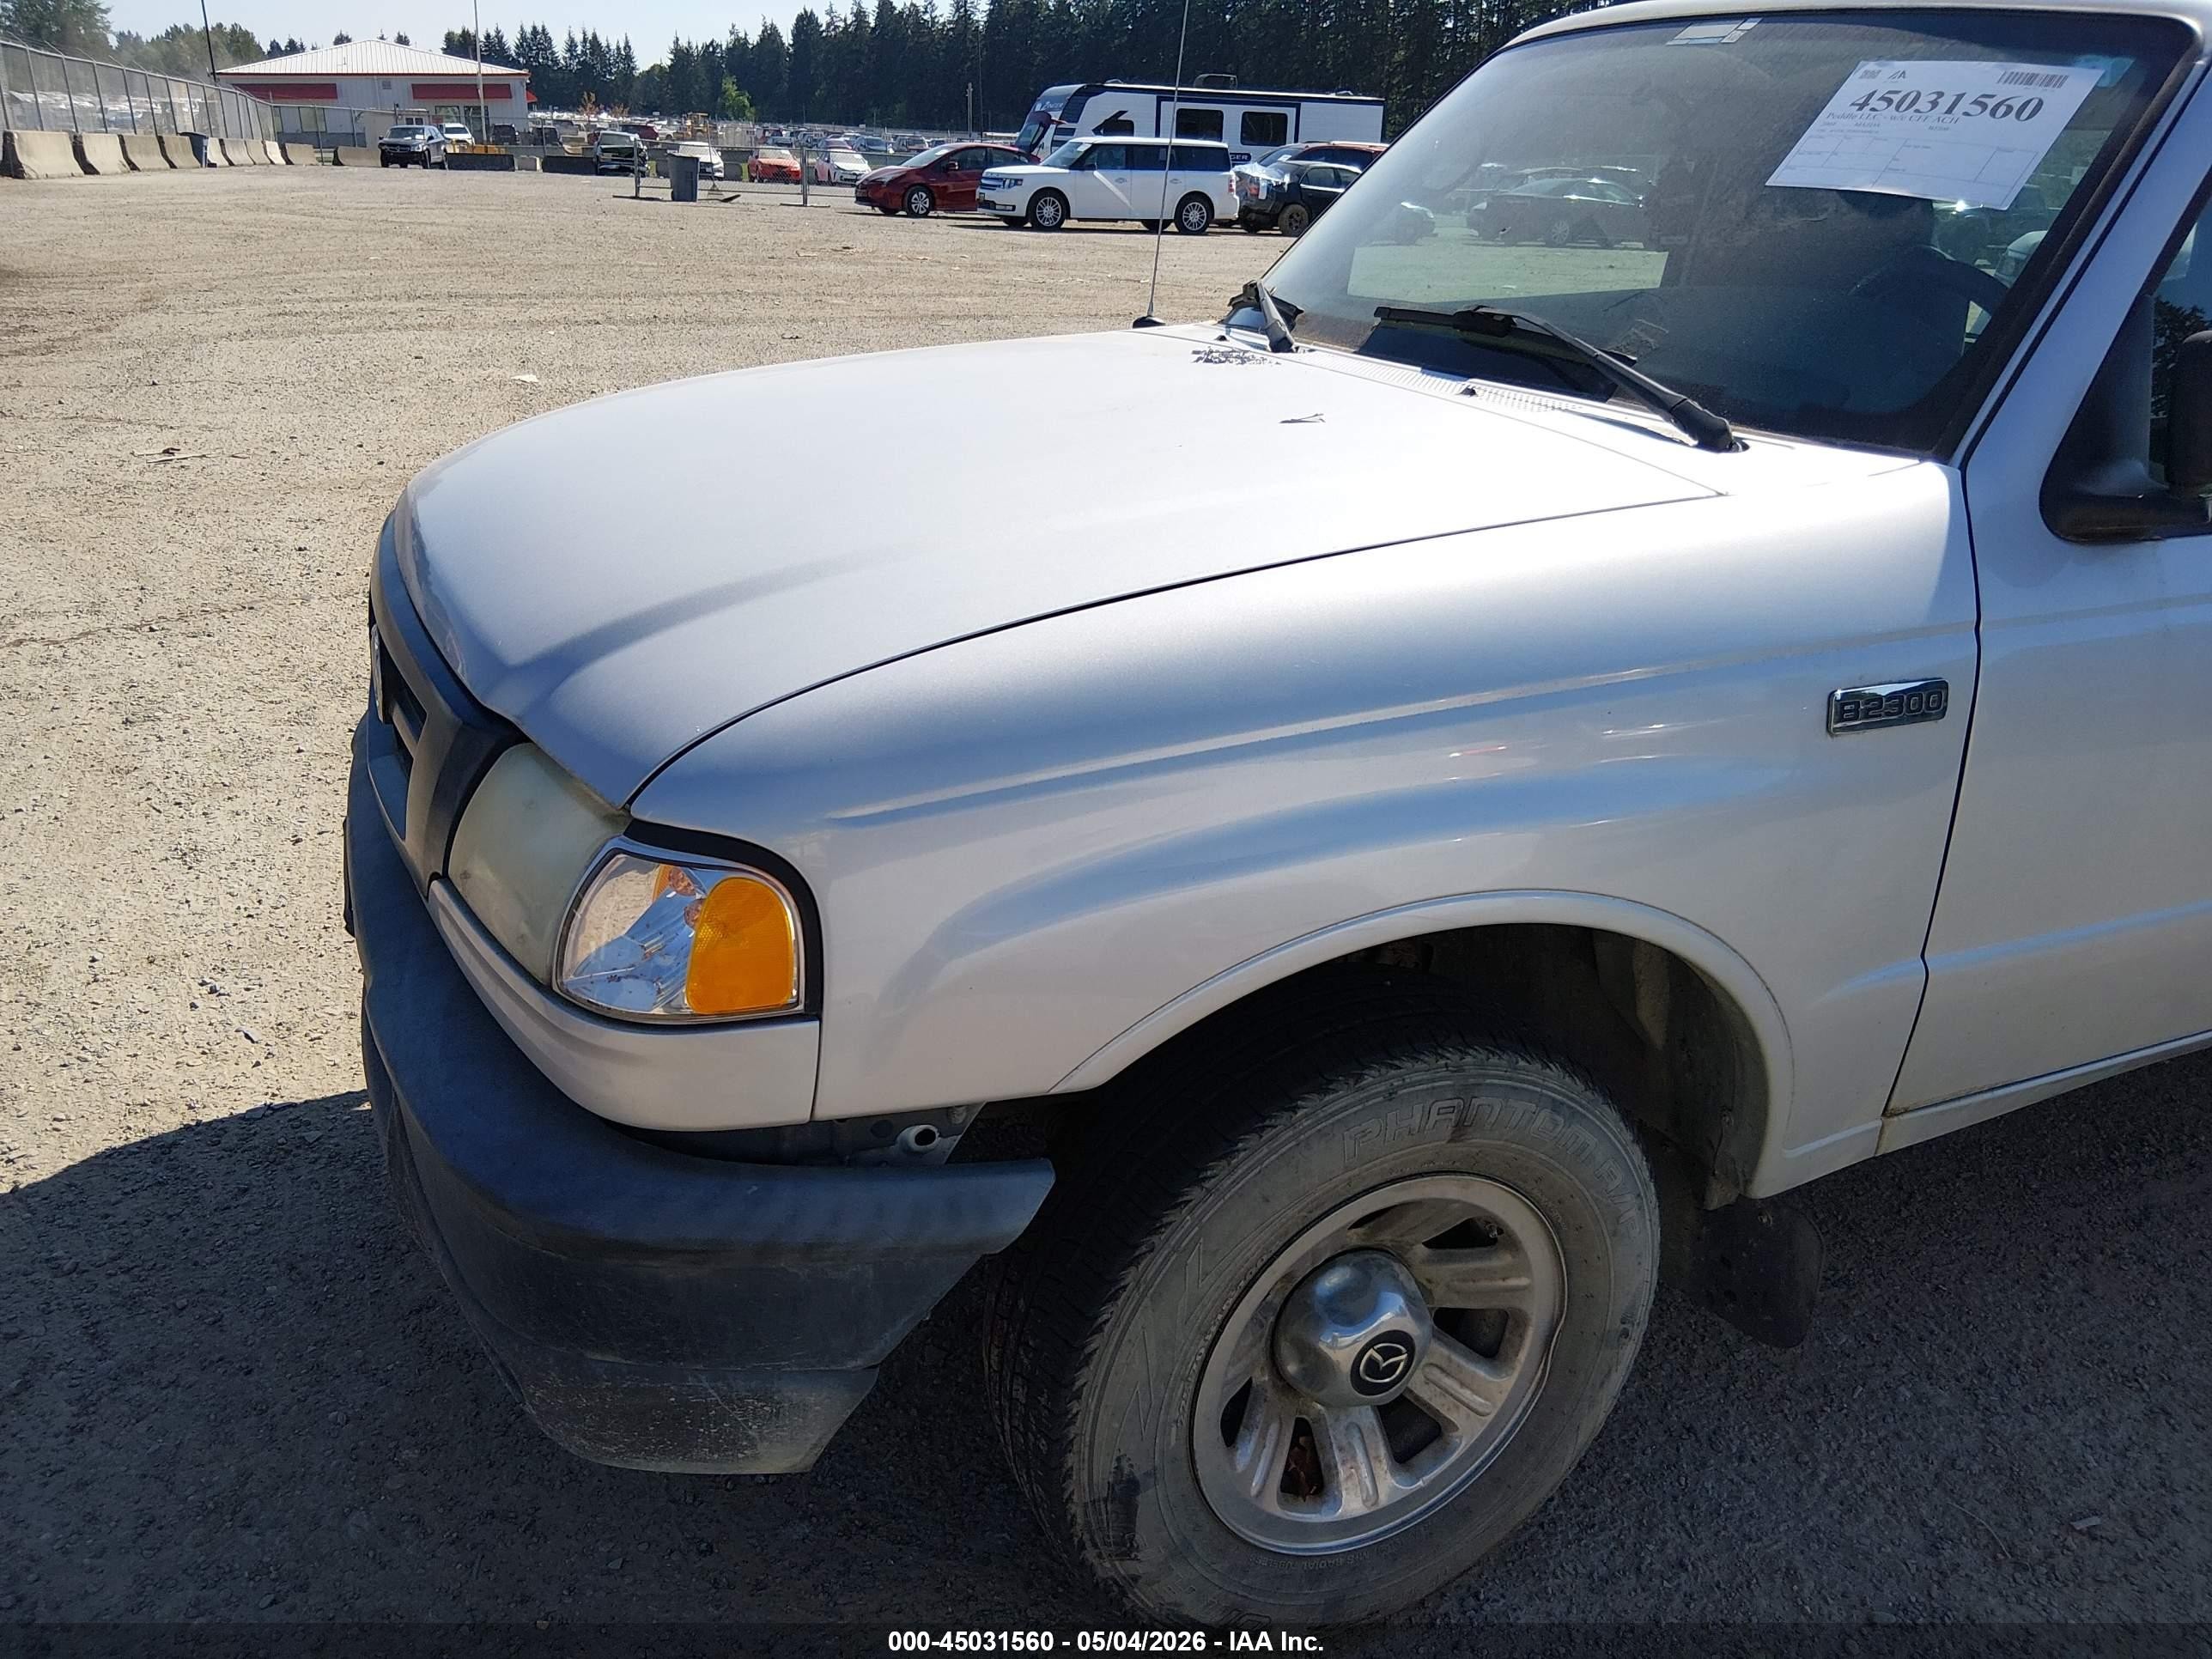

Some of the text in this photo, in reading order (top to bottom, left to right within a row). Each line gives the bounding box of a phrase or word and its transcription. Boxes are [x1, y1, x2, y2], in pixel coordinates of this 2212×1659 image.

[1849, 89, 2045, 122] 45031560
[1839, 690, 1945, 721] B2300
[1341, 1097, 1599, 1163] PHANTOM
